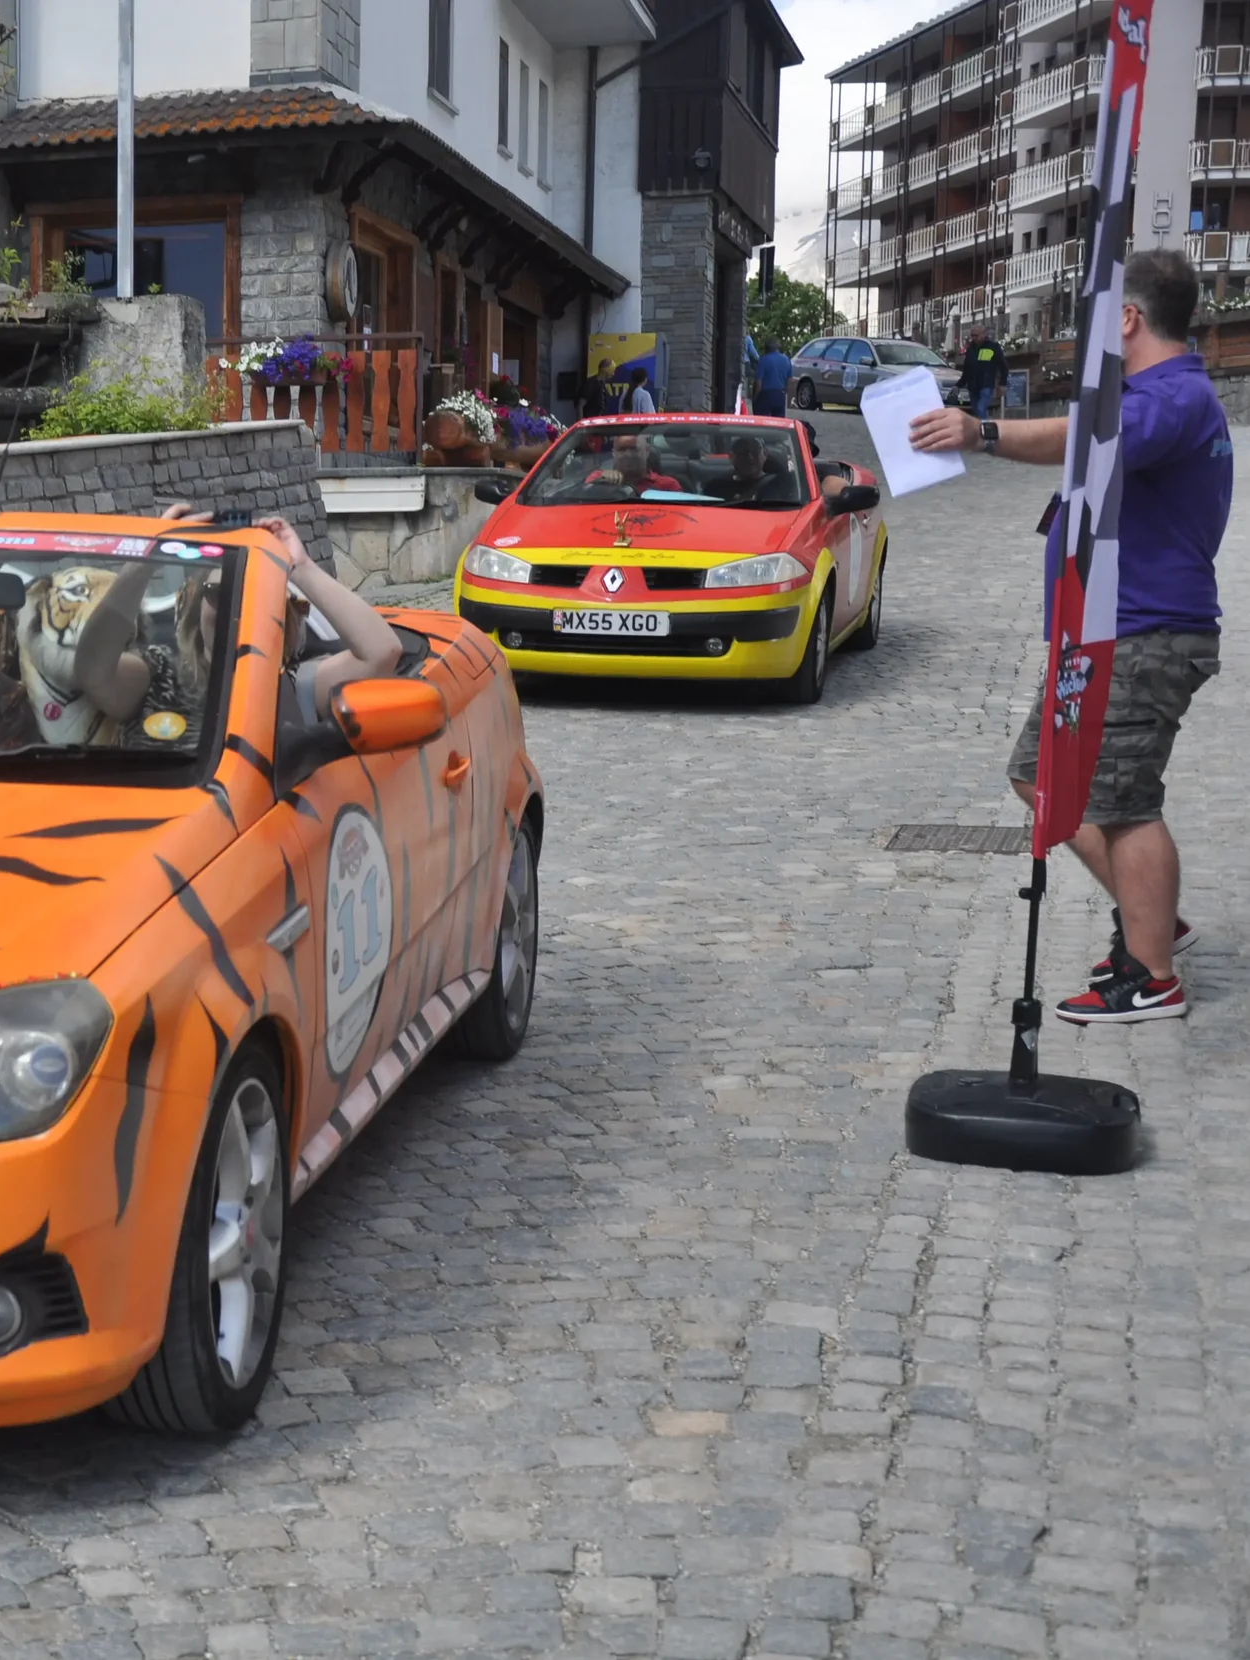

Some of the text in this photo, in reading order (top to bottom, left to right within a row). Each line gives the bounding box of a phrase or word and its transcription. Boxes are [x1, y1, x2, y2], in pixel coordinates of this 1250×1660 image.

[1152, 190, 1172, 247] HOT
[689, 416, 755, 424] Barcelona
[562, 611, 613, 631] MX55
[618, 613, 658, 632] XGO
[337, 864, 383, 994] 11
